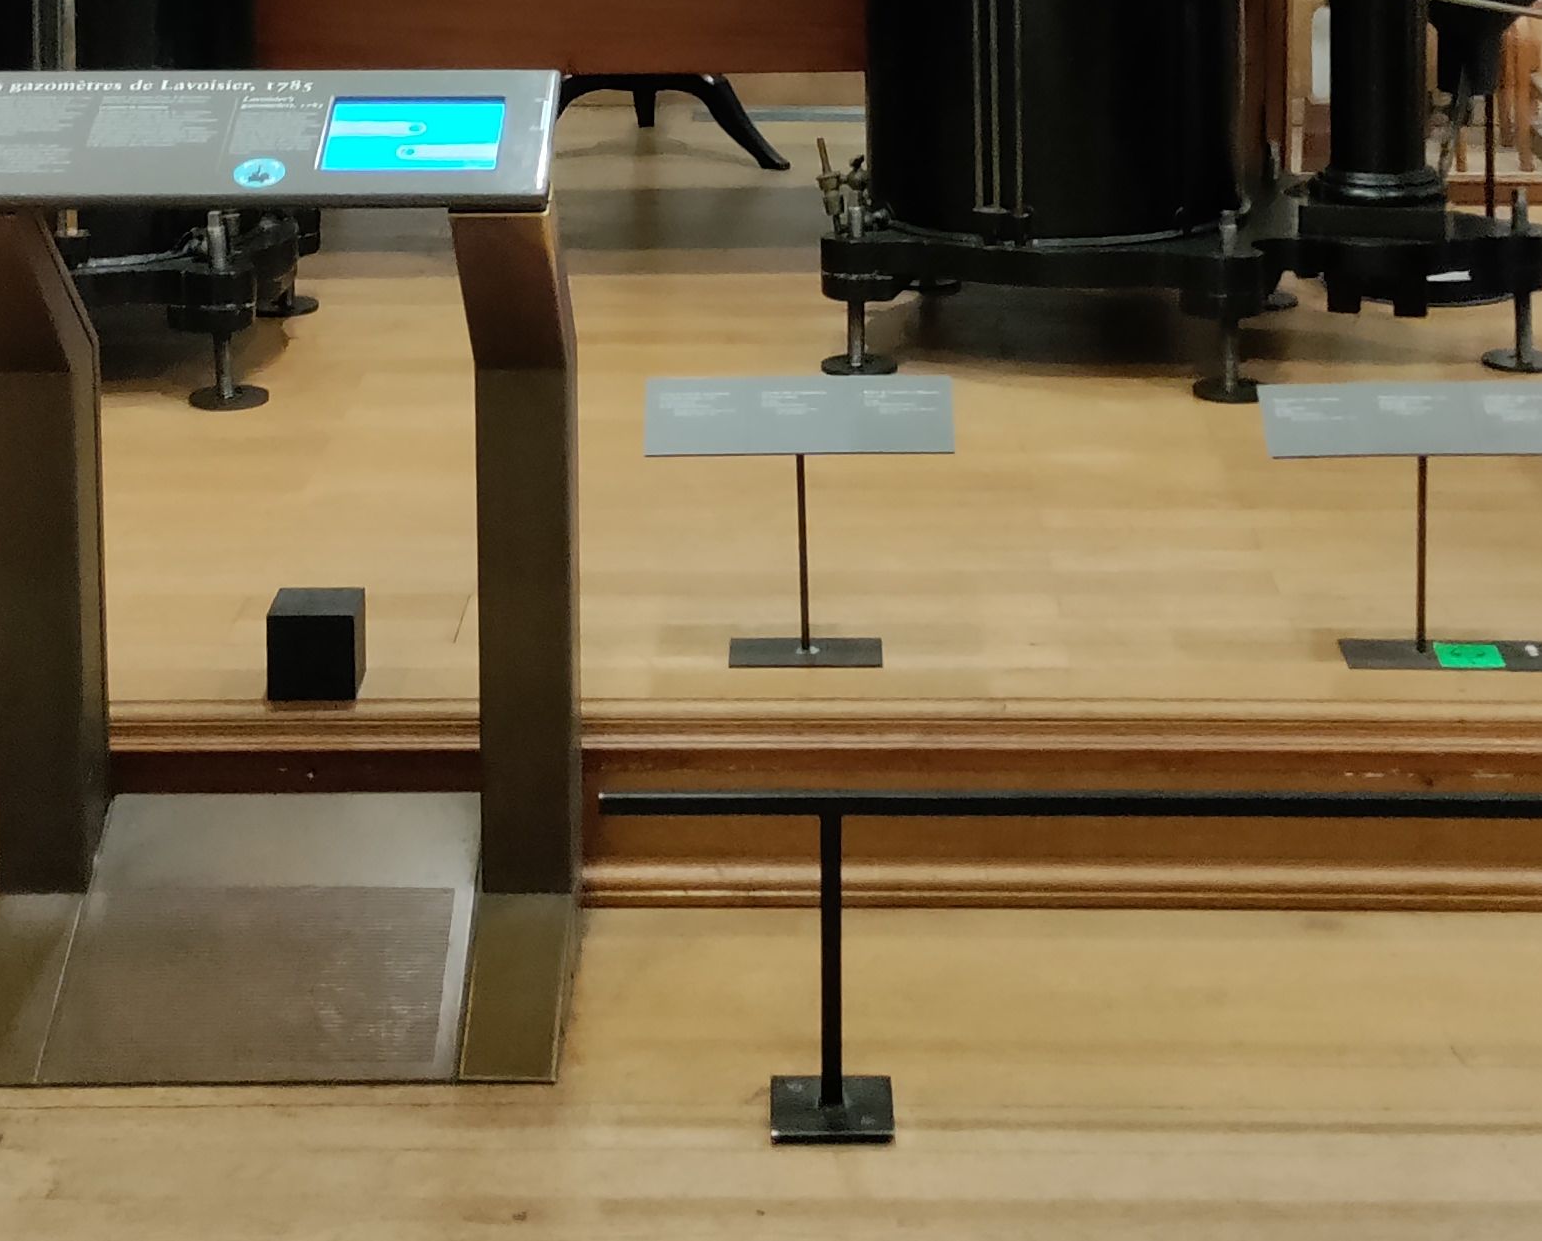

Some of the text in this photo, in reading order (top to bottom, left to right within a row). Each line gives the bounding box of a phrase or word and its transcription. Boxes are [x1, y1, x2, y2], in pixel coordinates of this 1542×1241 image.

[8, 78, 122, 93] gazomètres
[129, 79, 154, 92] de
[160, 79, 256, 93] Lavoisier,
[266, 79, 314, 93] 1785
